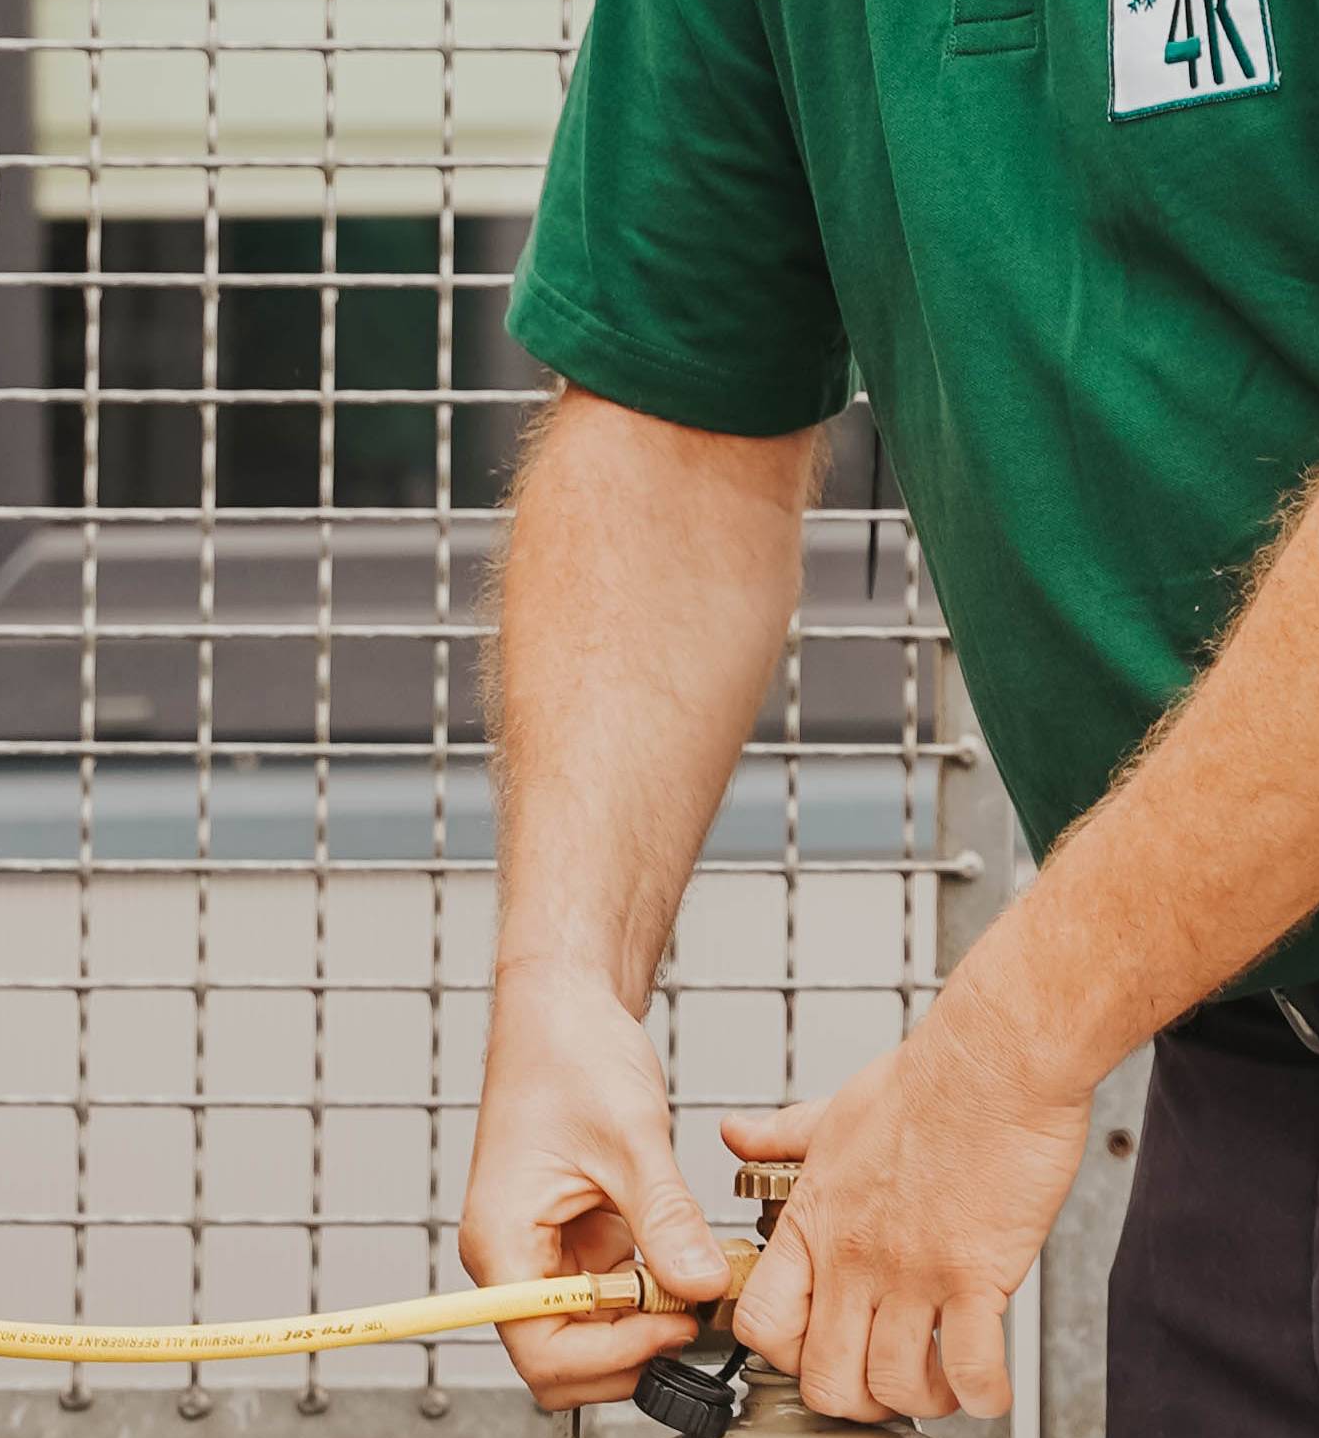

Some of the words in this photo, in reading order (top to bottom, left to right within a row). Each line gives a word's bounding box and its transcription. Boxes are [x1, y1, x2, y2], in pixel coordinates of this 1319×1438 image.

[1165, 937, 1257, 1089] 4K
[19, 1331, 74, 1347] BARRIER
[77, 1336, 160, 1348] REFRIGERANT
[164, 1336, 185, 1348] ALL
[190, 1335, 244, 1348] PREMIUM
